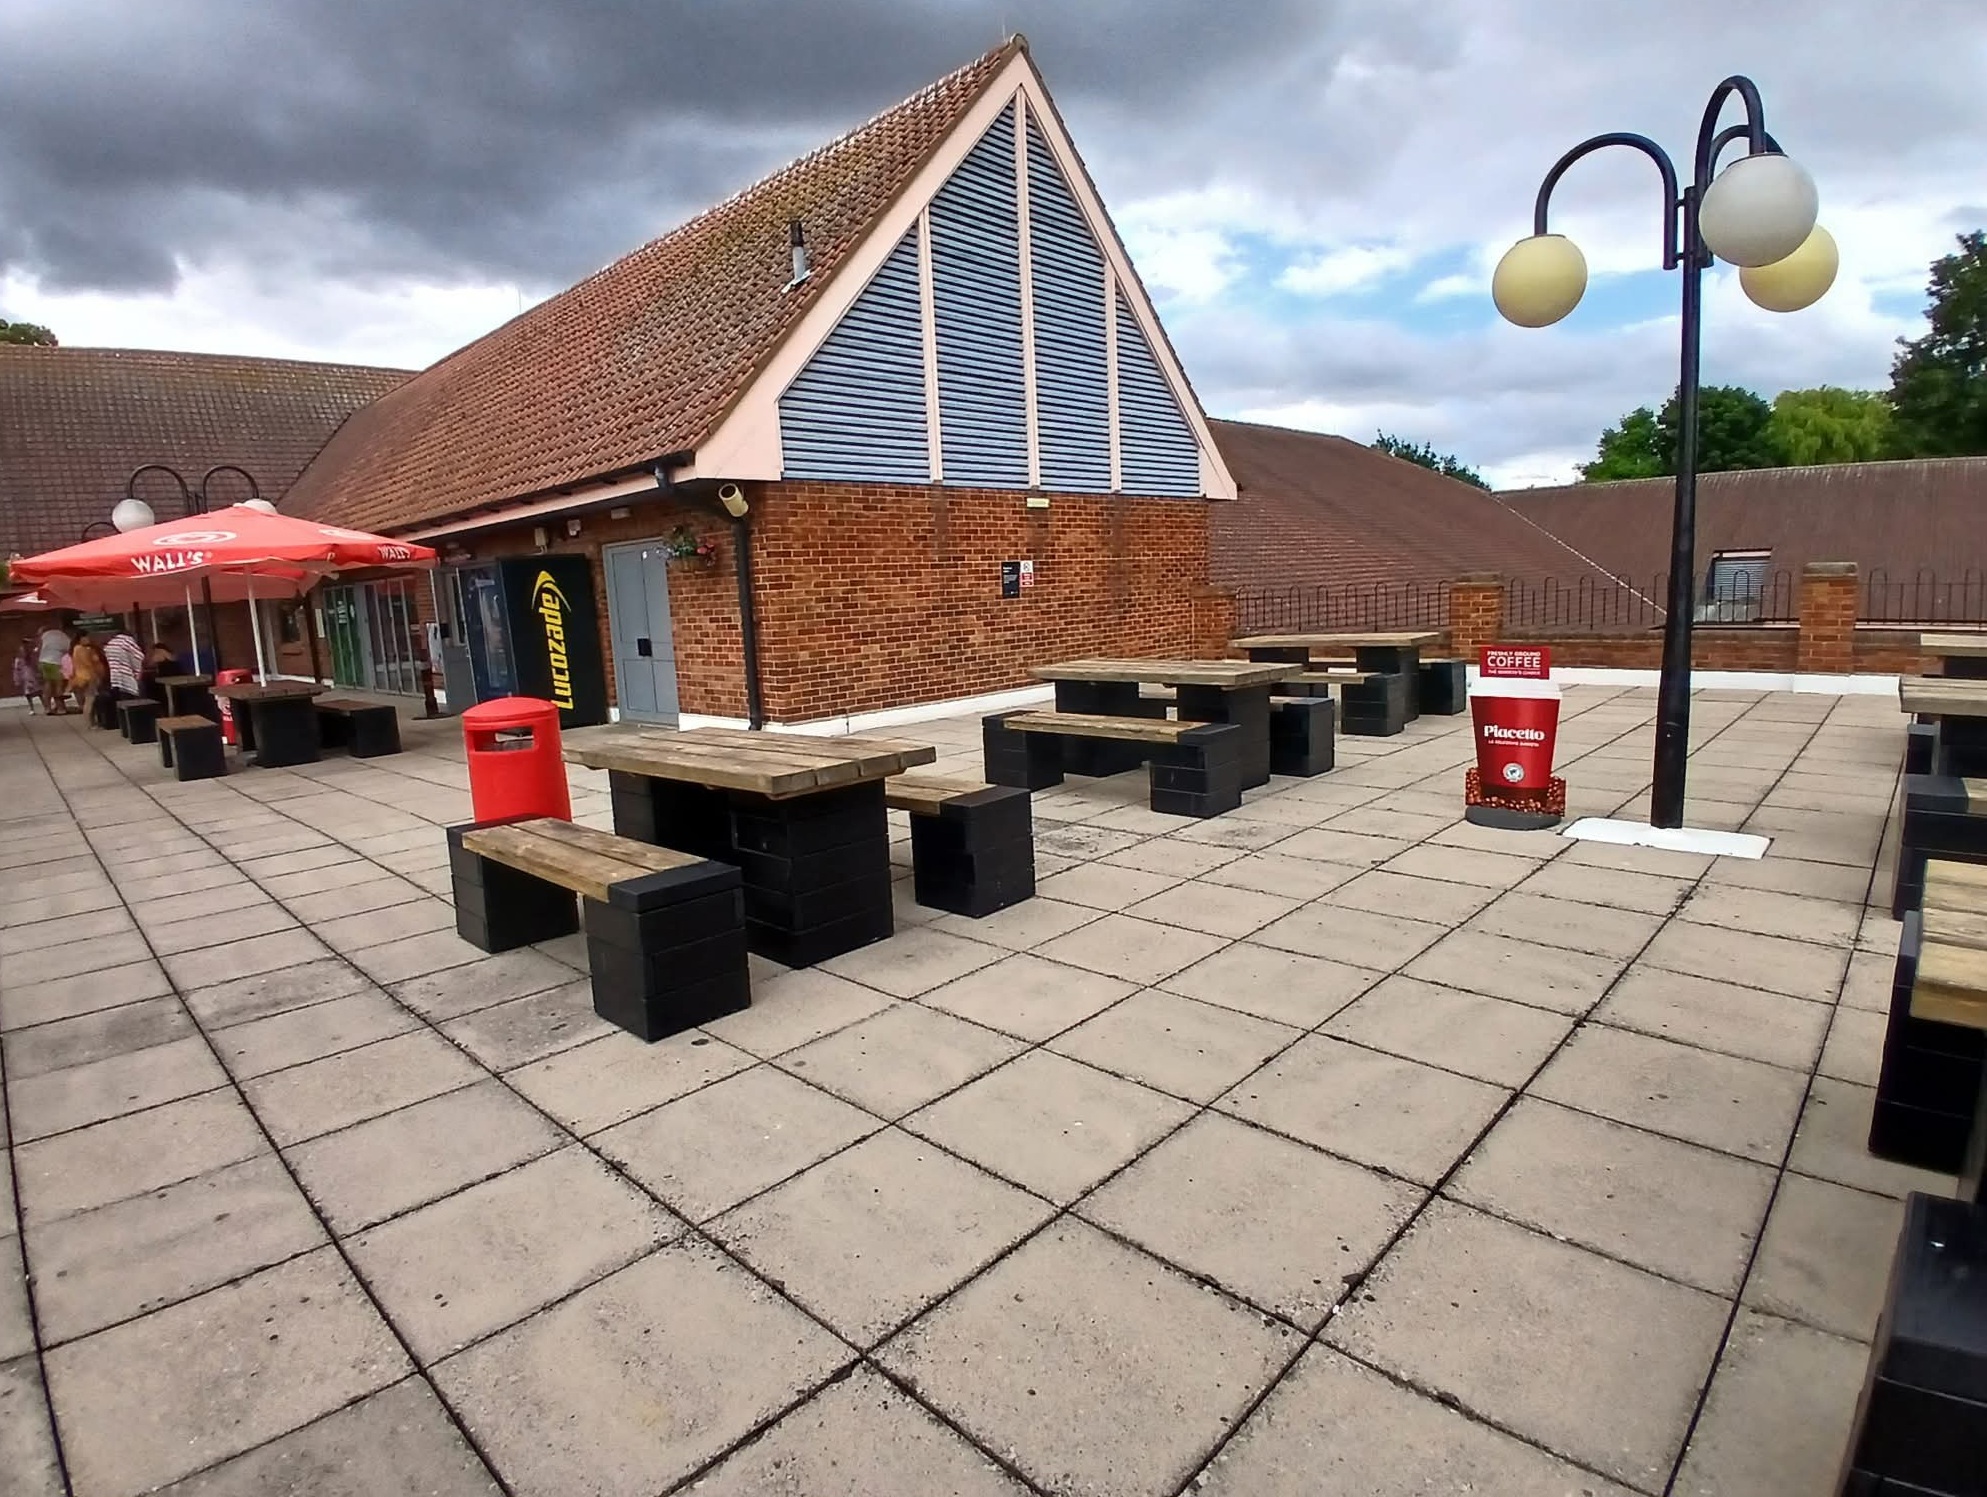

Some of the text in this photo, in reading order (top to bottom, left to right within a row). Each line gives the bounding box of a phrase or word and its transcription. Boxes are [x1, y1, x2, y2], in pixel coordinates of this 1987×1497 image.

[130, 551, 204, 573] WALL'S
[538, 592, 574, 710] Lucozade
[1487, 656, 1541, 668] COFFEE
[1483, 724, 1545, 741] Piacetto
